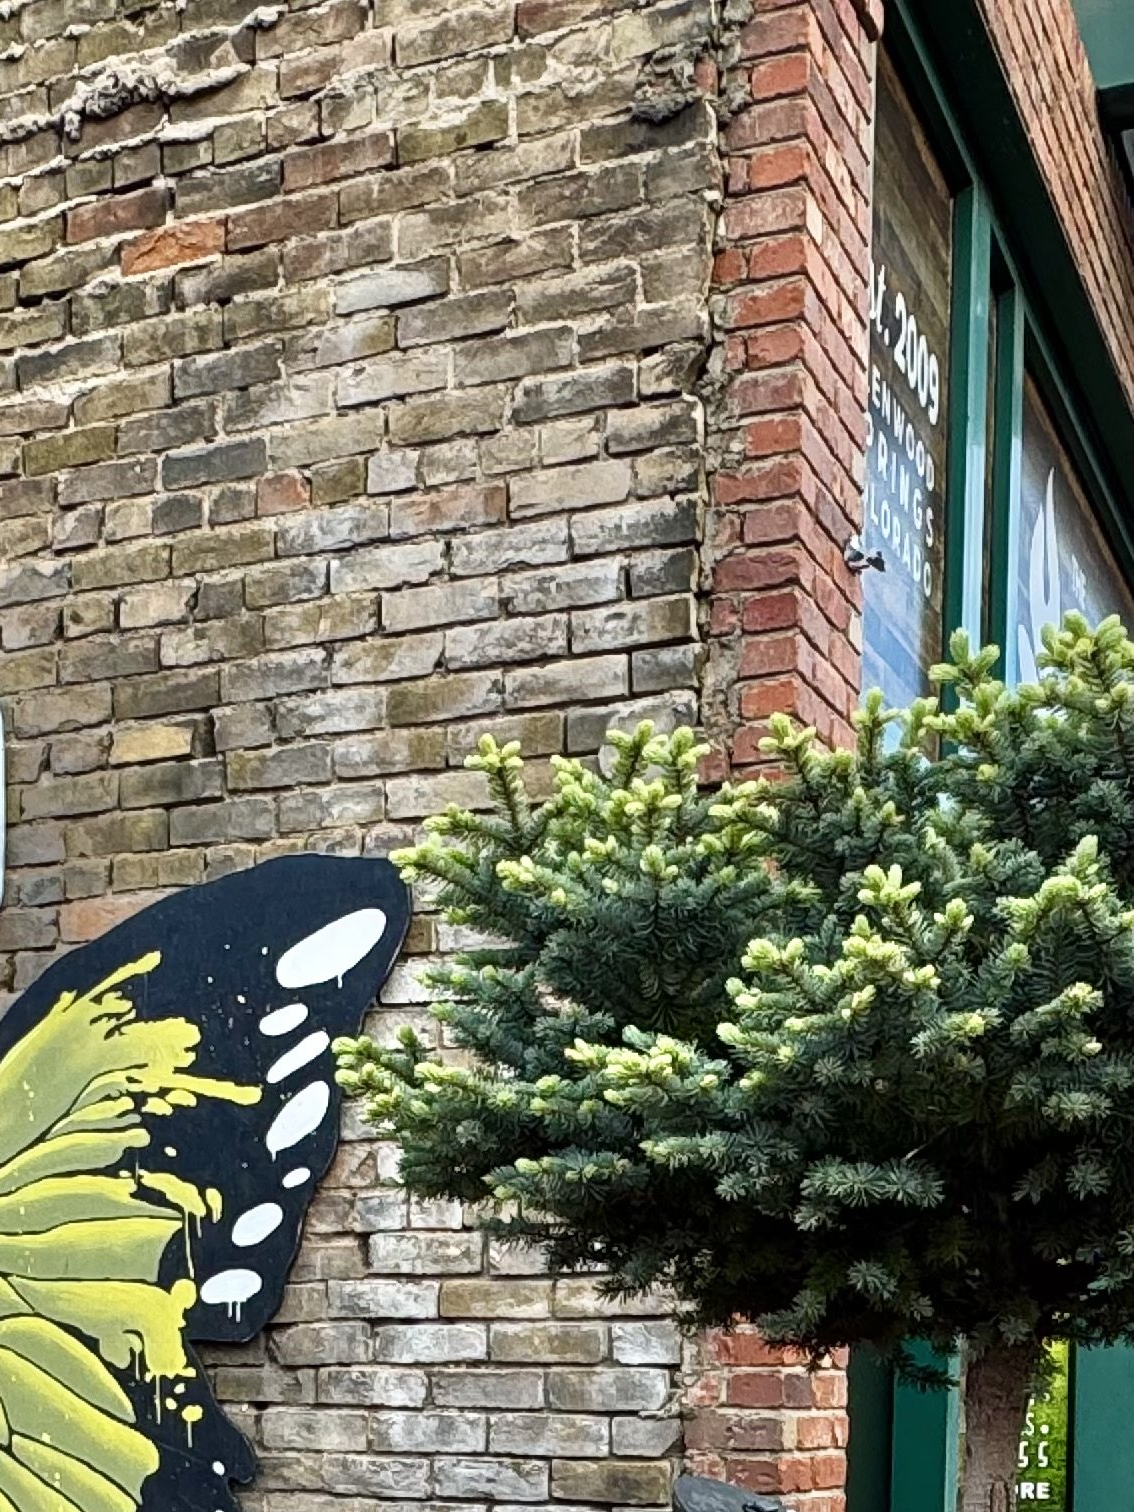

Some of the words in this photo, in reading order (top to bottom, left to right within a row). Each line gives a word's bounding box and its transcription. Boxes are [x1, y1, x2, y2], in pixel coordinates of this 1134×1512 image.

[893, 291, 939, 426] 2009
[867, 364, 934, 492] ENWOOD
[865, 481, 932, 598] LORADO
